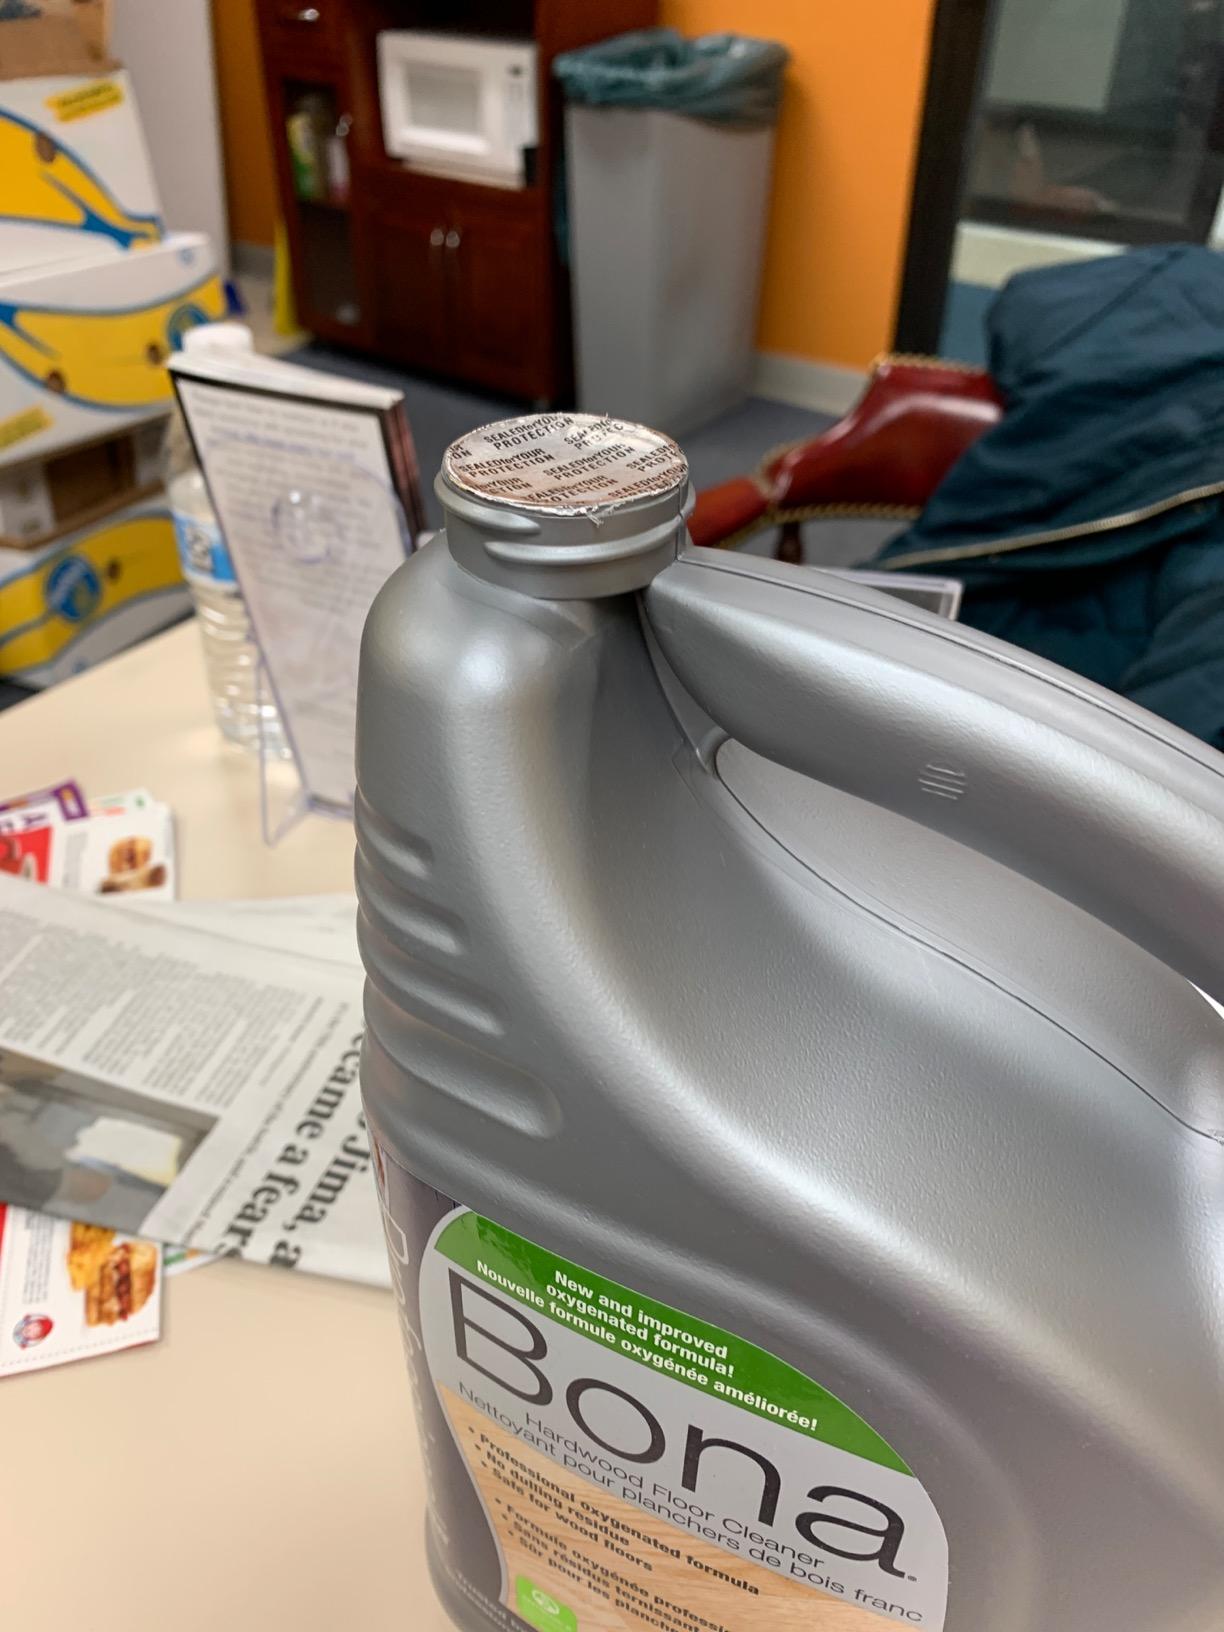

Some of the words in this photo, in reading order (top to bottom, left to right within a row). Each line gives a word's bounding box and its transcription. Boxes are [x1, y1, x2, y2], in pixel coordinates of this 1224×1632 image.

[468, 454, 555, 477] PROTECTION
[493, 416, 574, 450] PROTECTION
[554, 446, 635, 480] PROTECTION
[276, 1143, 309, 1168] a
[282, 1135, 371, 1233] Jima,
[476, 1260, 544, 1307] Nouvelle
[549, 1301, 616, 1344] formule
[621, 1338, 709, 1386] oxygénée
[713, 1380, 818, 1431] améliorée!
[546, 1285, 648, 1341] oxygenated
[653, 1333, 735, 1378] formula!
[555, 1270, 593, 1299] New
[598, 1294, 632, 1318] and
[638, 1310, 727, 1359] improved
[448, 1267, 907, 1578] Bona
[459, 1381, 556, 1457] Nettoyant
[563, 1454, 615, 1488] pour
[622, 1487, 740, 1550] planchers
[749, 1546, 781, 1568] de
[789, 1560, 845, 1594] bois
[853, 1586, 923, 1622] franc
[480, 1433, 575, 1502] Professional
[580, 1501, 681, 1559] oxygenated
[687, 1555, 759, 1595] formula
[486, 1451, 506, 1471] No
[510, 1468, 563, 1510] dulling
[567, 1504, 630, 1546] residue
[492, 1467, 525, 1496] Safe
[529, 1493, 551, 1513] for
[555, 1511, 599, 1543] wood
[603, 1539, 653, 1571] floors
[526, 1412, 643, 1489] Hardwood
[652, 1483, 716, 1521] Floor
[722, 1518, 825, 1568] Cleaner
[506, 1504, 568, 1550] Formule
[571, 1549, 649, 1597] oxygénée
[653, 1595, 732, 1632] professi
[513, 1521, 549, 1551] Sans
[553, 1549, 610, 1588] résidus
[548, 1557, 582, 1583] pour
[587, 1580, 610, 1600] les
